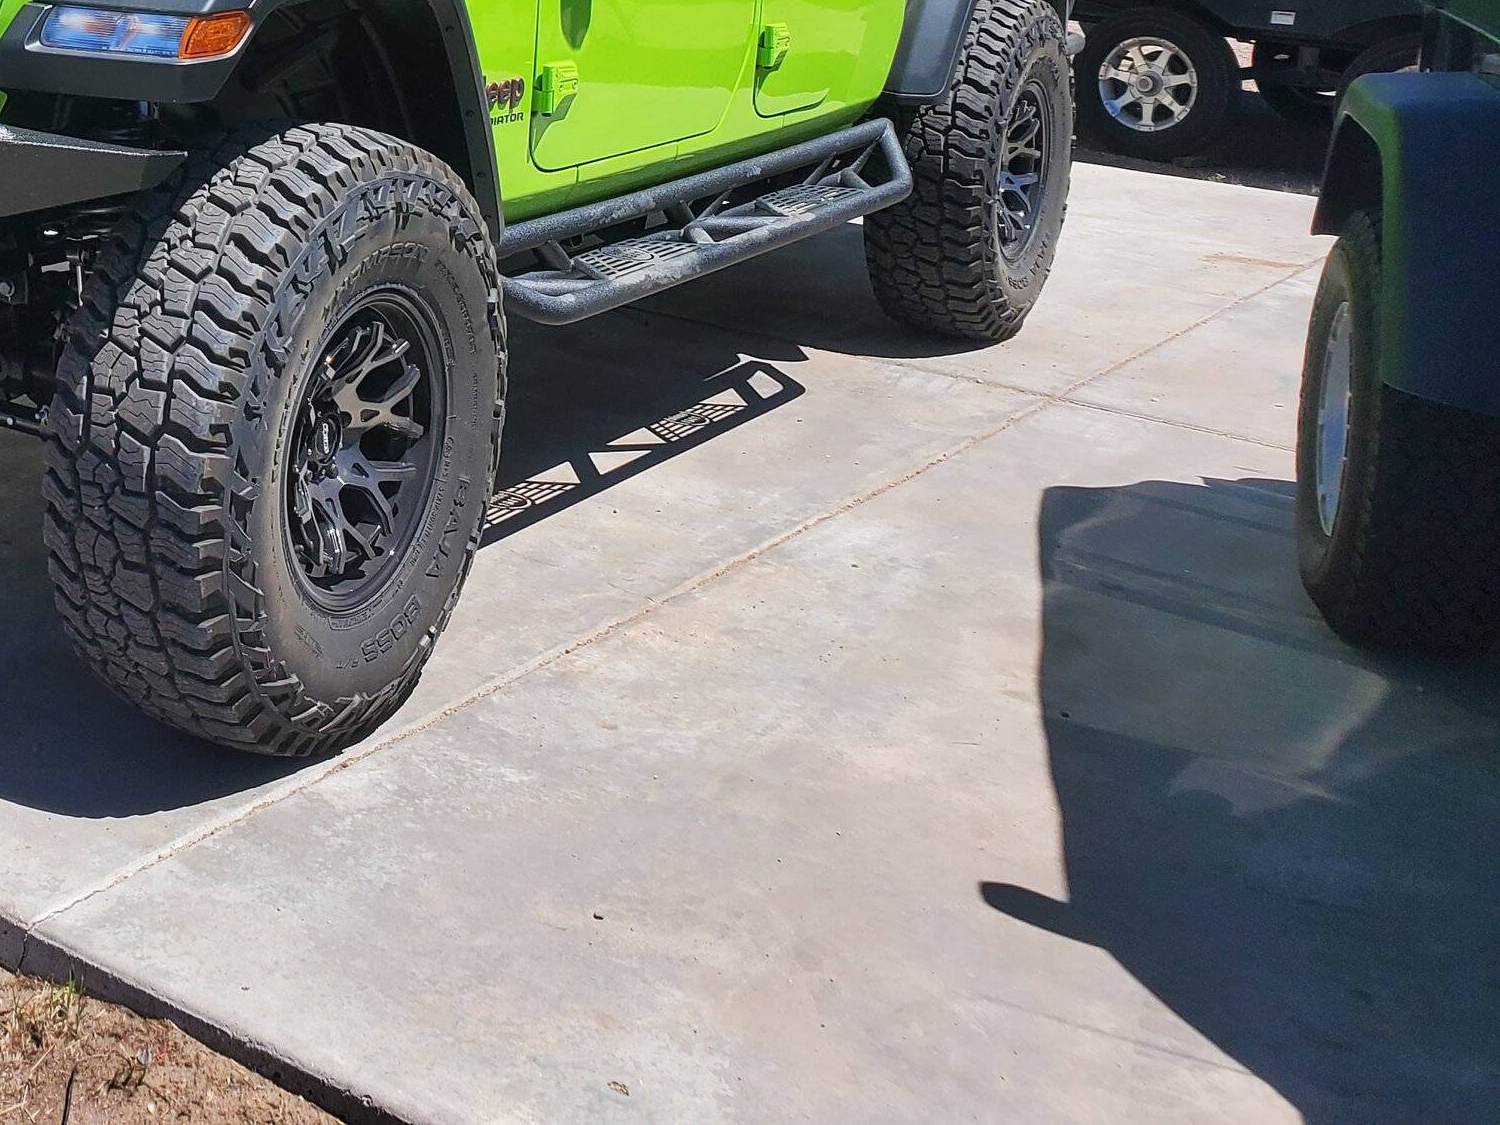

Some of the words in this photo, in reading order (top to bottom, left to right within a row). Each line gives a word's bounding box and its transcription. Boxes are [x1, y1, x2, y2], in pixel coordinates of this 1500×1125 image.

[485, 76, 525, 113] eep
[424, 474, 471, 579] BAJA
[359, 593, 422, 662] BOSS
